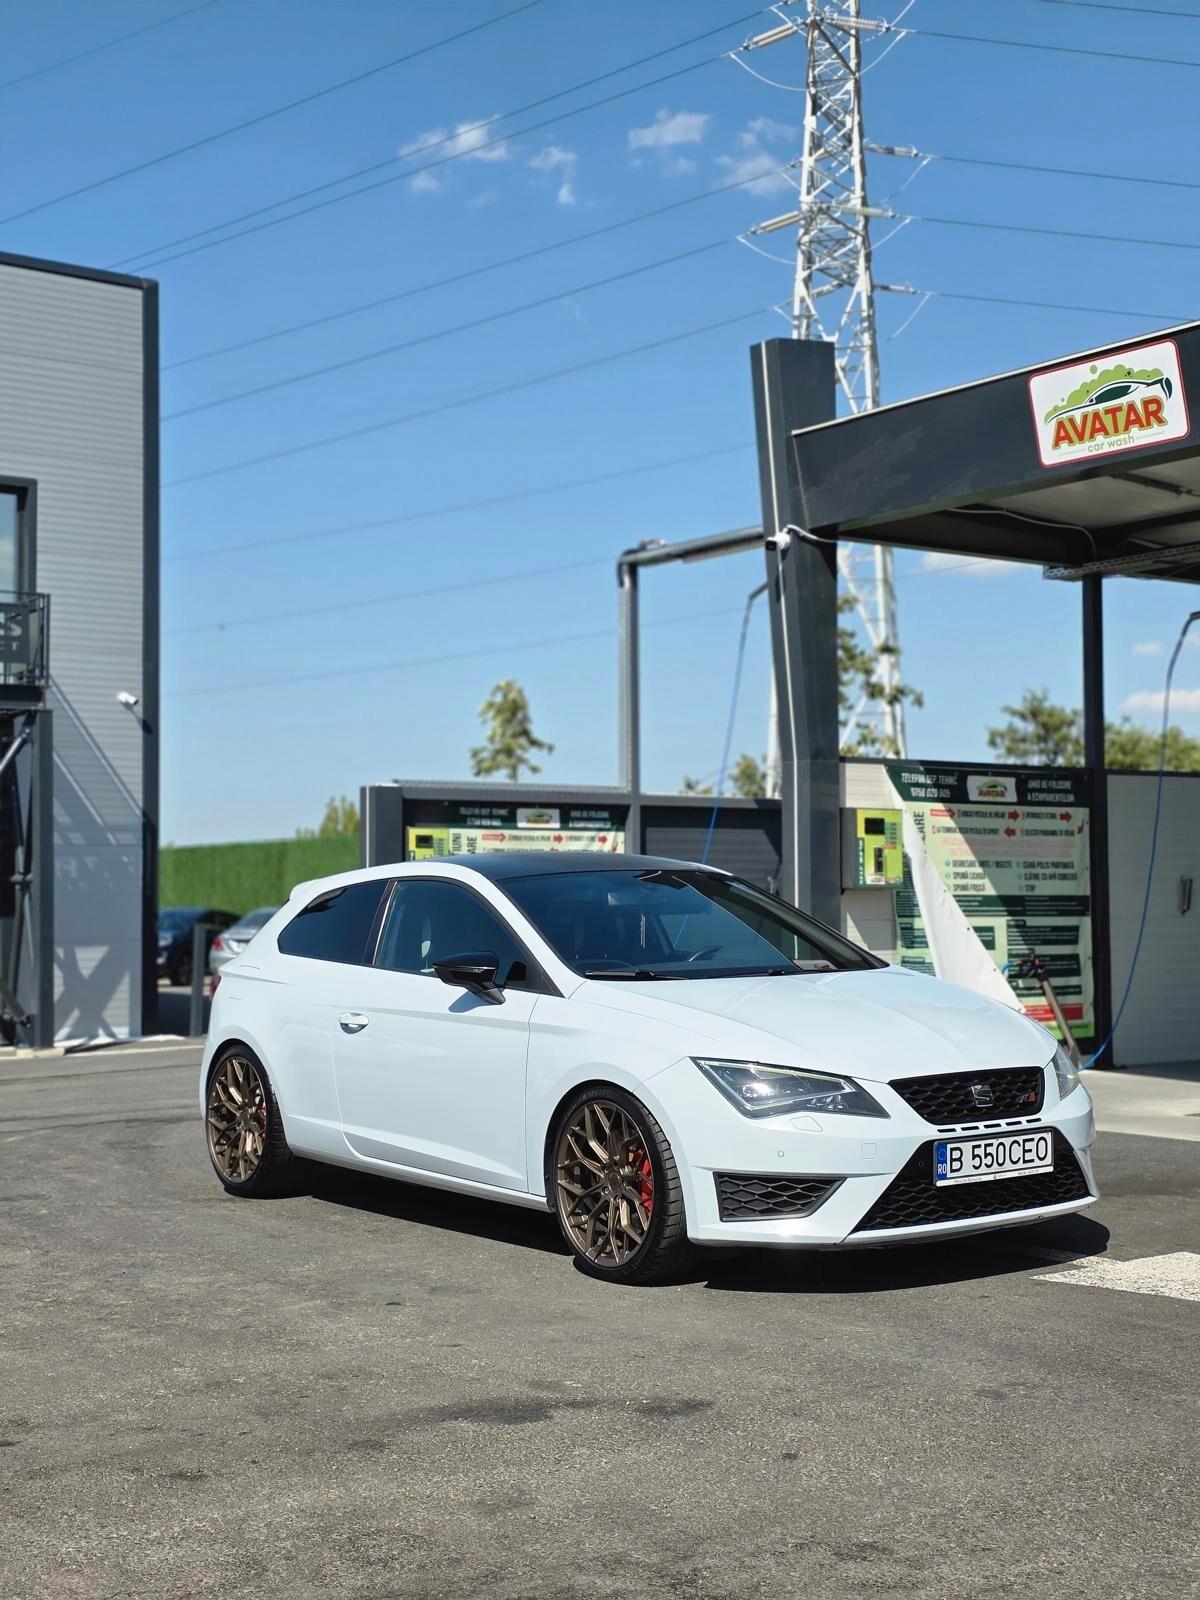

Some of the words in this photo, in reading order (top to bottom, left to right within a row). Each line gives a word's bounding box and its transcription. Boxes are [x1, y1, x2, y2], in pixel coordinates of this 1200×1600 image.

[1052, 396, 1167, 449] AVATAR
[1087, 440, 1104, 453] car
[1107, 435, 1135, 449] wash
[937, 1163, 947, 1175] RO
[949, 1146, 963, 1173] B
